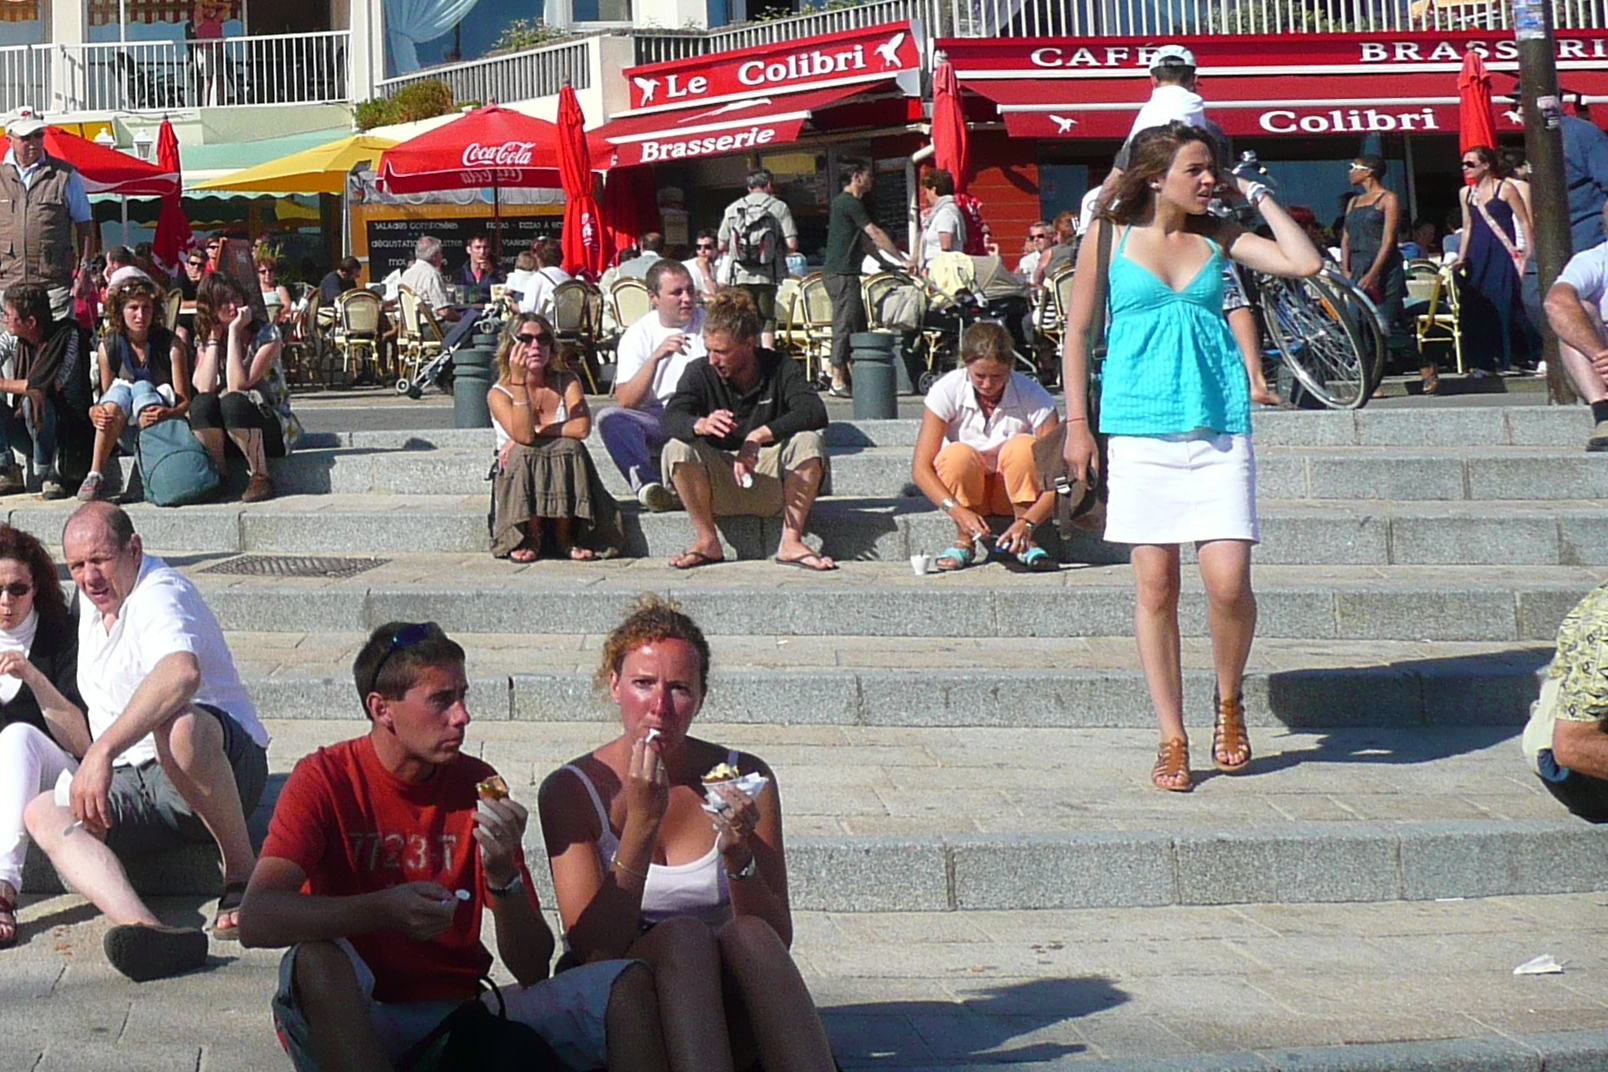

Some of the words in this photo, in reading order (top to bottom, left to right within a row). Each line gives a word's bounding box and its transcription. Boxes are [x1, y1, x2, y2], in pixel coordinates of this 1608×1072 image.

[1360, 39, 1608, 62] BRASSRI
[666, 73, 708, 99] Le
[737, 44, 867, 86] Colibri
[1259, 107, 1440, 133] Colibri
[462, 141, 536, 167] Coca-Cola
[640, 126, 776, 164] Brasserie
